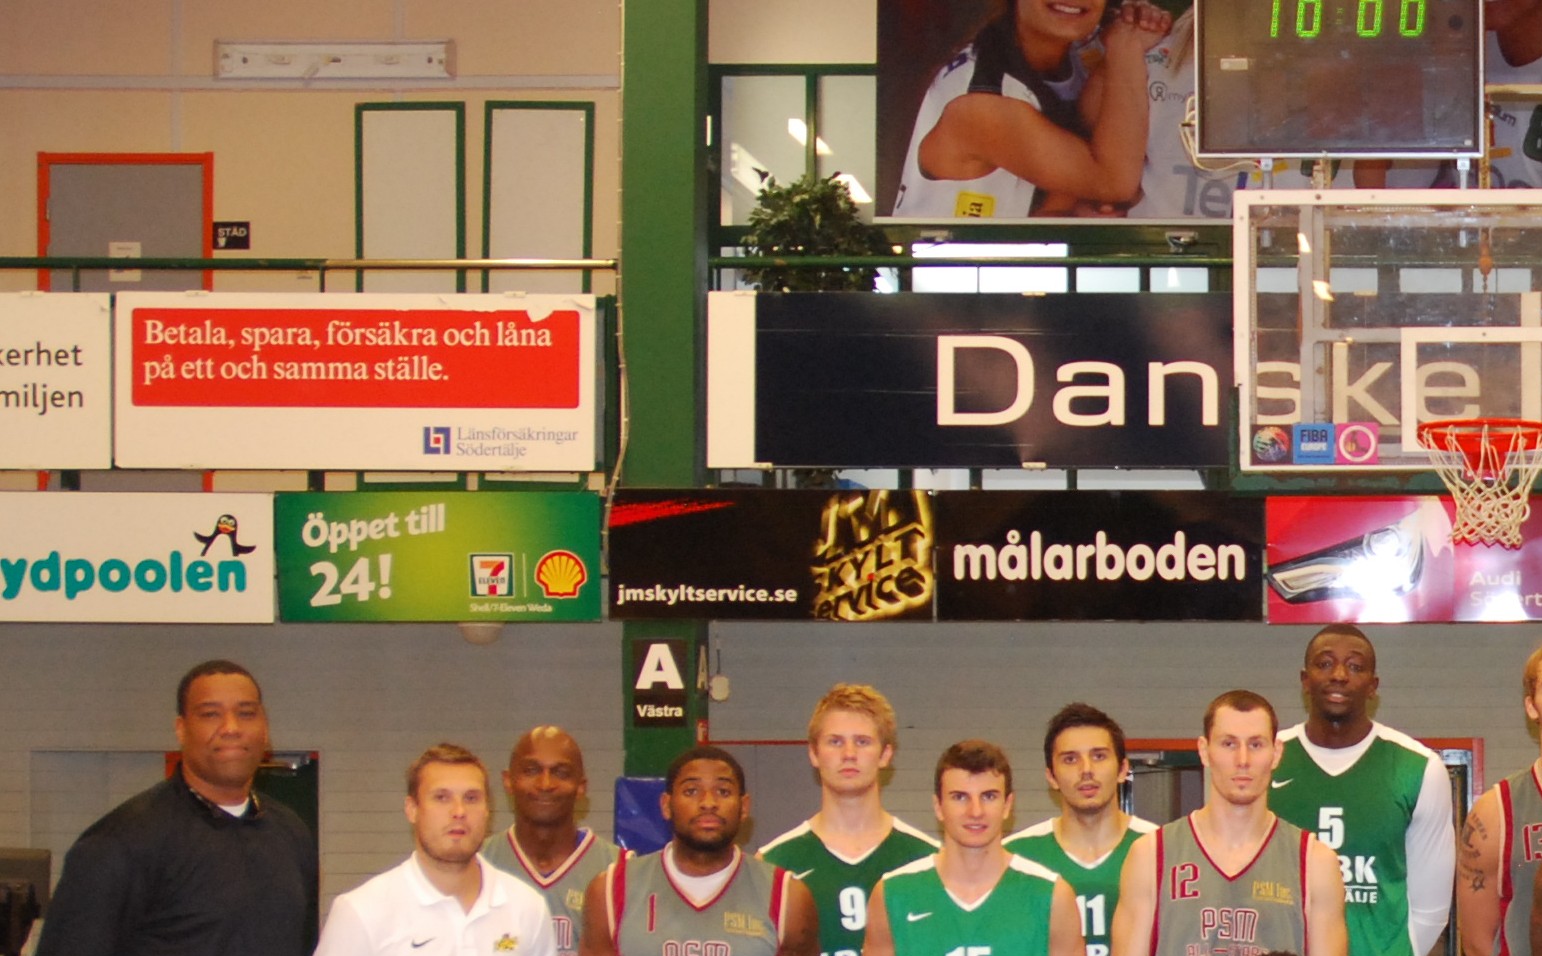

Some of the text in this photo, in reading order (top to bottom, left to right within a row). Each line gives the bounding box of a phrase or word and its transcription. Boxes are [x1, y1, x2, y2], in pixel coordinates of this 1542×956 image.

[144, 319, 552, 351] Betala, spara, försäkra och låna
[144, 354, 450, 386] på ett och samma ställe.
[936, 335, 1481, 426] Danske
[456, 443, 527, 458] Södertälje
[457, 427, 579, 445] Länsförsäkringar
[1300, 429, 1328, 442] FIBA
[302, 503, 446, 554] Öppet till
[953, 529, 1247, 582] målarboden
[0, 550, 247, 600] ydpoolen
[310, 553, 392, 607] 24!
[1469, 570, 1522, 586] Audi
[617, 583, 798, 606] jmskyltservice.se
[635, 643, 686, 690] A
[636, 702, 684, 719] Västra
[1318, 807, 1345, 850] 5
[1170, 862, 1201, 900] 12
[838, 886, 867, 931] 9
[1200, 907, 1260, 943] PSM
